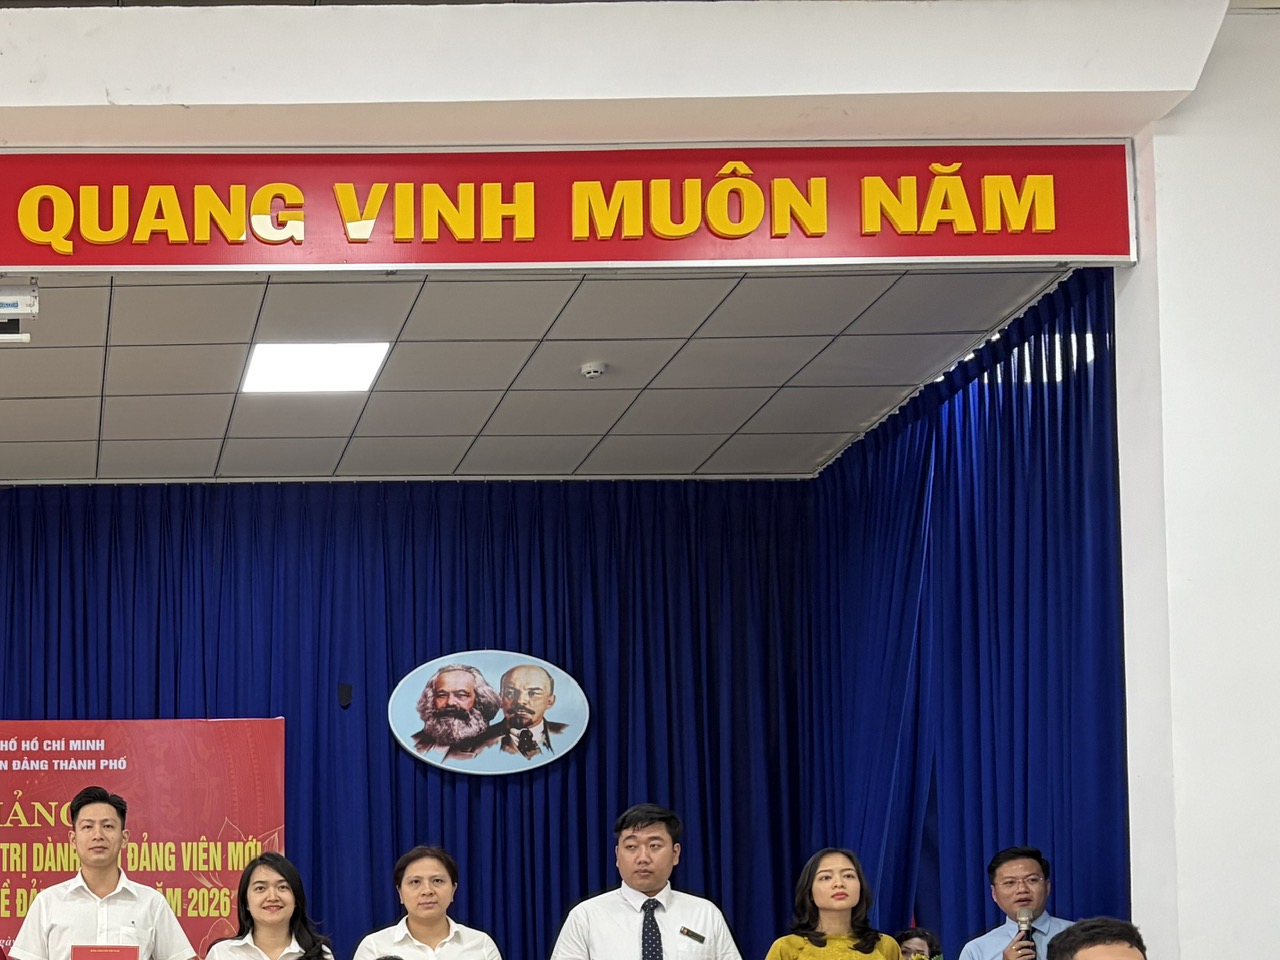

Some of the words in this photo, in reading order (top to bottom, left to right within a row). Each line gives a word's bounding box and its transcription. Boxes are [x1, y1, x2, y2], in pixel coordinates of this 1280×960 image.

[17, 182, 305, 255] QUANG
[332, 182, 536, 243] VINH
[571, 161, 828, 240] MUÔN
[860, 162, 1056, 235] NĂM
[43, 737, 65, 752] CHÍ
[69, 739, 105, 751] MINH
[12, 756, 49, 771] ĐẢNG
[52, 757, 96, 771] THÀNH
[100, 755, 127, 770] PHỐ
[0, 842, 27, 879] TRỊ
[126, 832, 176, 872] ĐẢNG
[180, 836, 222, 872] VIÊN
[187, 887, 231, 918] 2026
